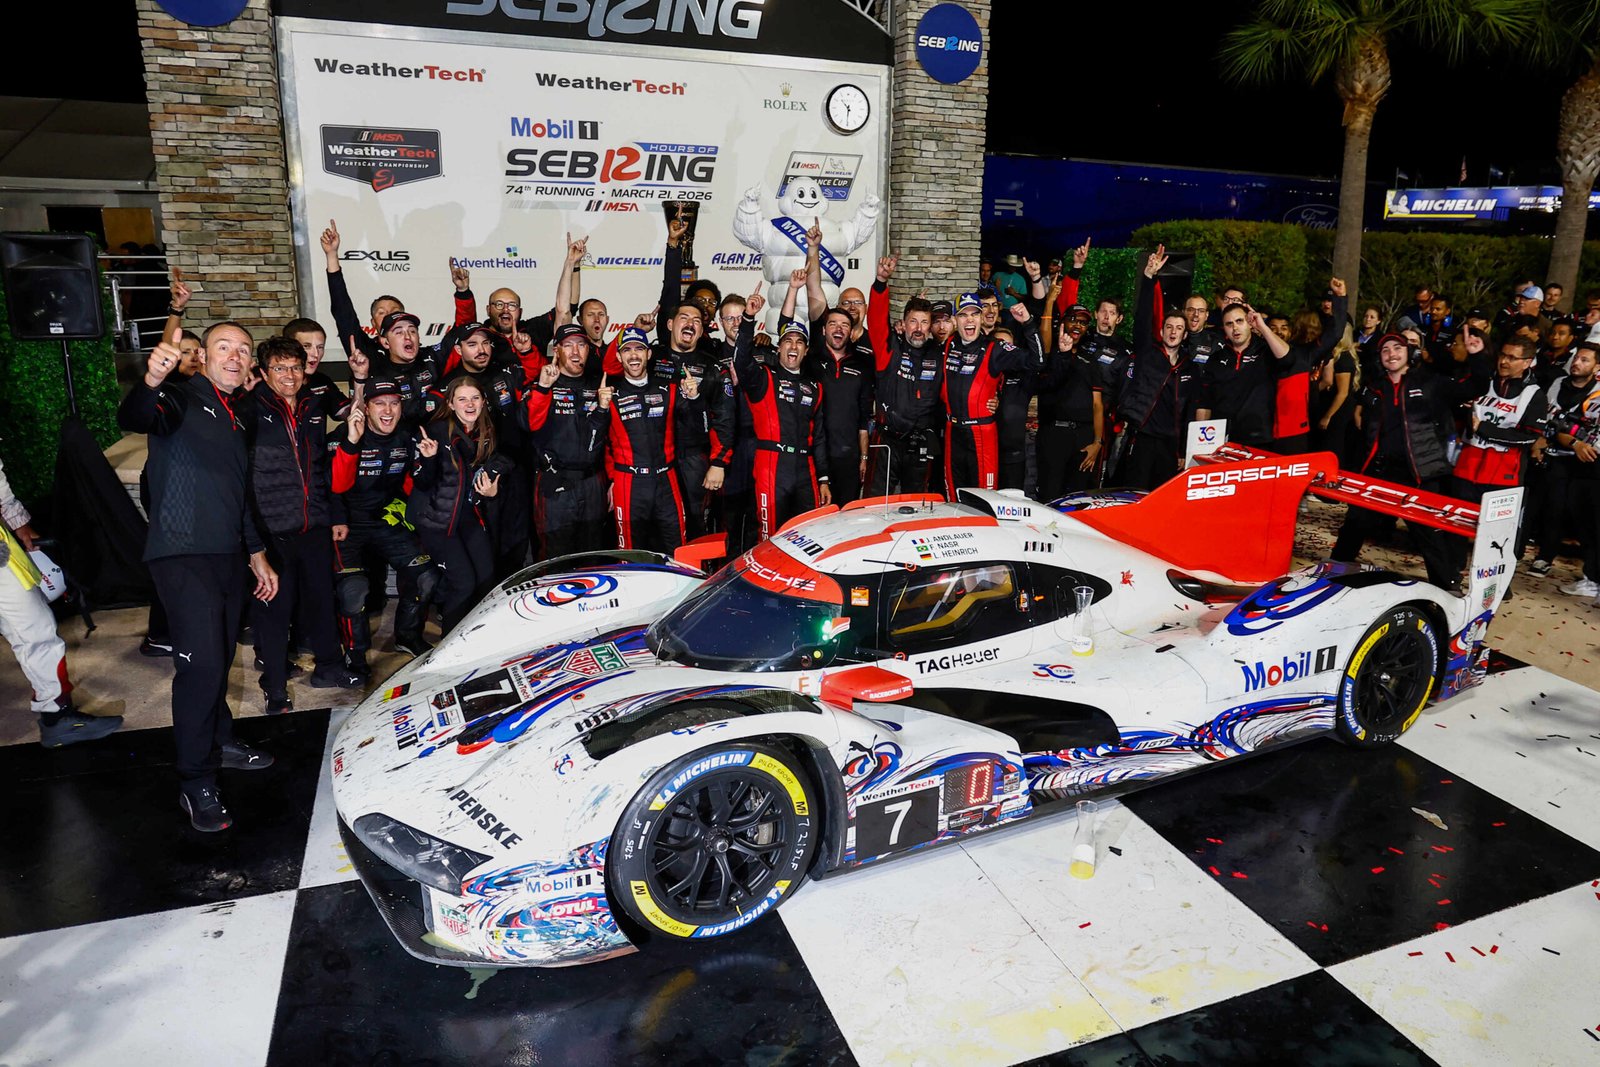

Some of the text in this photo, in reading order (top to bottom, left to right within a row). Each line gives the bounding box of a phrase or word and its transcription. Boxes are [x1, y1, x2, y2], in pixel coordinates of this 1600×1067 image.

[314, 58, 484, 82] WeatherTech
[536, 72, 686, 96] WeatherTech
[764, 98, 808, 112] ROLEX
[372, 132, 405, 142] IMSA
[510, 116, 574, 139] Mobil
[328, 144, 437, 159] WeatherTech
[650, 143, 716, 154] HOURS OF
[505, 185, 532, 195] 74th
[535, 187, 595, 197] RUNNING
[611, 189, 654, 199] MARCH
[677, 191, 712, 200] 2026
[602, 202, 640, 212] IMSA
[1412, 198, 1498, 212] MICHELIN
[712, 253, 762, 266] ALAN JA
[781, 220, 844, 279] MICELIN
[373, 262, 410, 272] RACING
[596, 257, 663, 266] MICHELIN
[1187, 462, 1310, 488] PORSCHE
[1186, 484, 1236, 500] 963
[998, 506, 1022, 516] Mobil
[1496, 510, 1512, 518] BOSCH
[782, 530, 813, 548] Mobil
[932, 532, 974, 542] ANDLAUER
[942, 548, 978, 558] HEINRICH
[743, 550, 816, 592] PORSCHE
[1477, 566, 1498, 580] Mobil
[595, 646, 619, 670] TAG
[1426, 629, 1438, 672] MICHELIN
[575, 650, 600, 675] HEUER
[1241, 651, 1312, 692] Mobil
[463, 678, 514, 702] 7
[510, 666, 531, 699] WeatherTech
[1344, 682, 1358, 729] MICHELIN
[392, 704, 417, 737] Mobil
[1150, 738, 1174, 748] GTP
[334, 757, 344, 778] IMSA
[672, 753, 747, 790] MICHELIN
[758, 758, 794, 785] PILOT SPORT
[862, 778, 936, 802] WeatherTech
[968, 764, 990, 804] 0
[796, 801, 806, 813] M
[450, 789, 523, 850] PENSKE
[884, 800, 913, 846] 7
[526, 877, 574, 894] Mobil
[634, 885, 646, 896] M
[700, 900, 770, 937] MICHELIN
